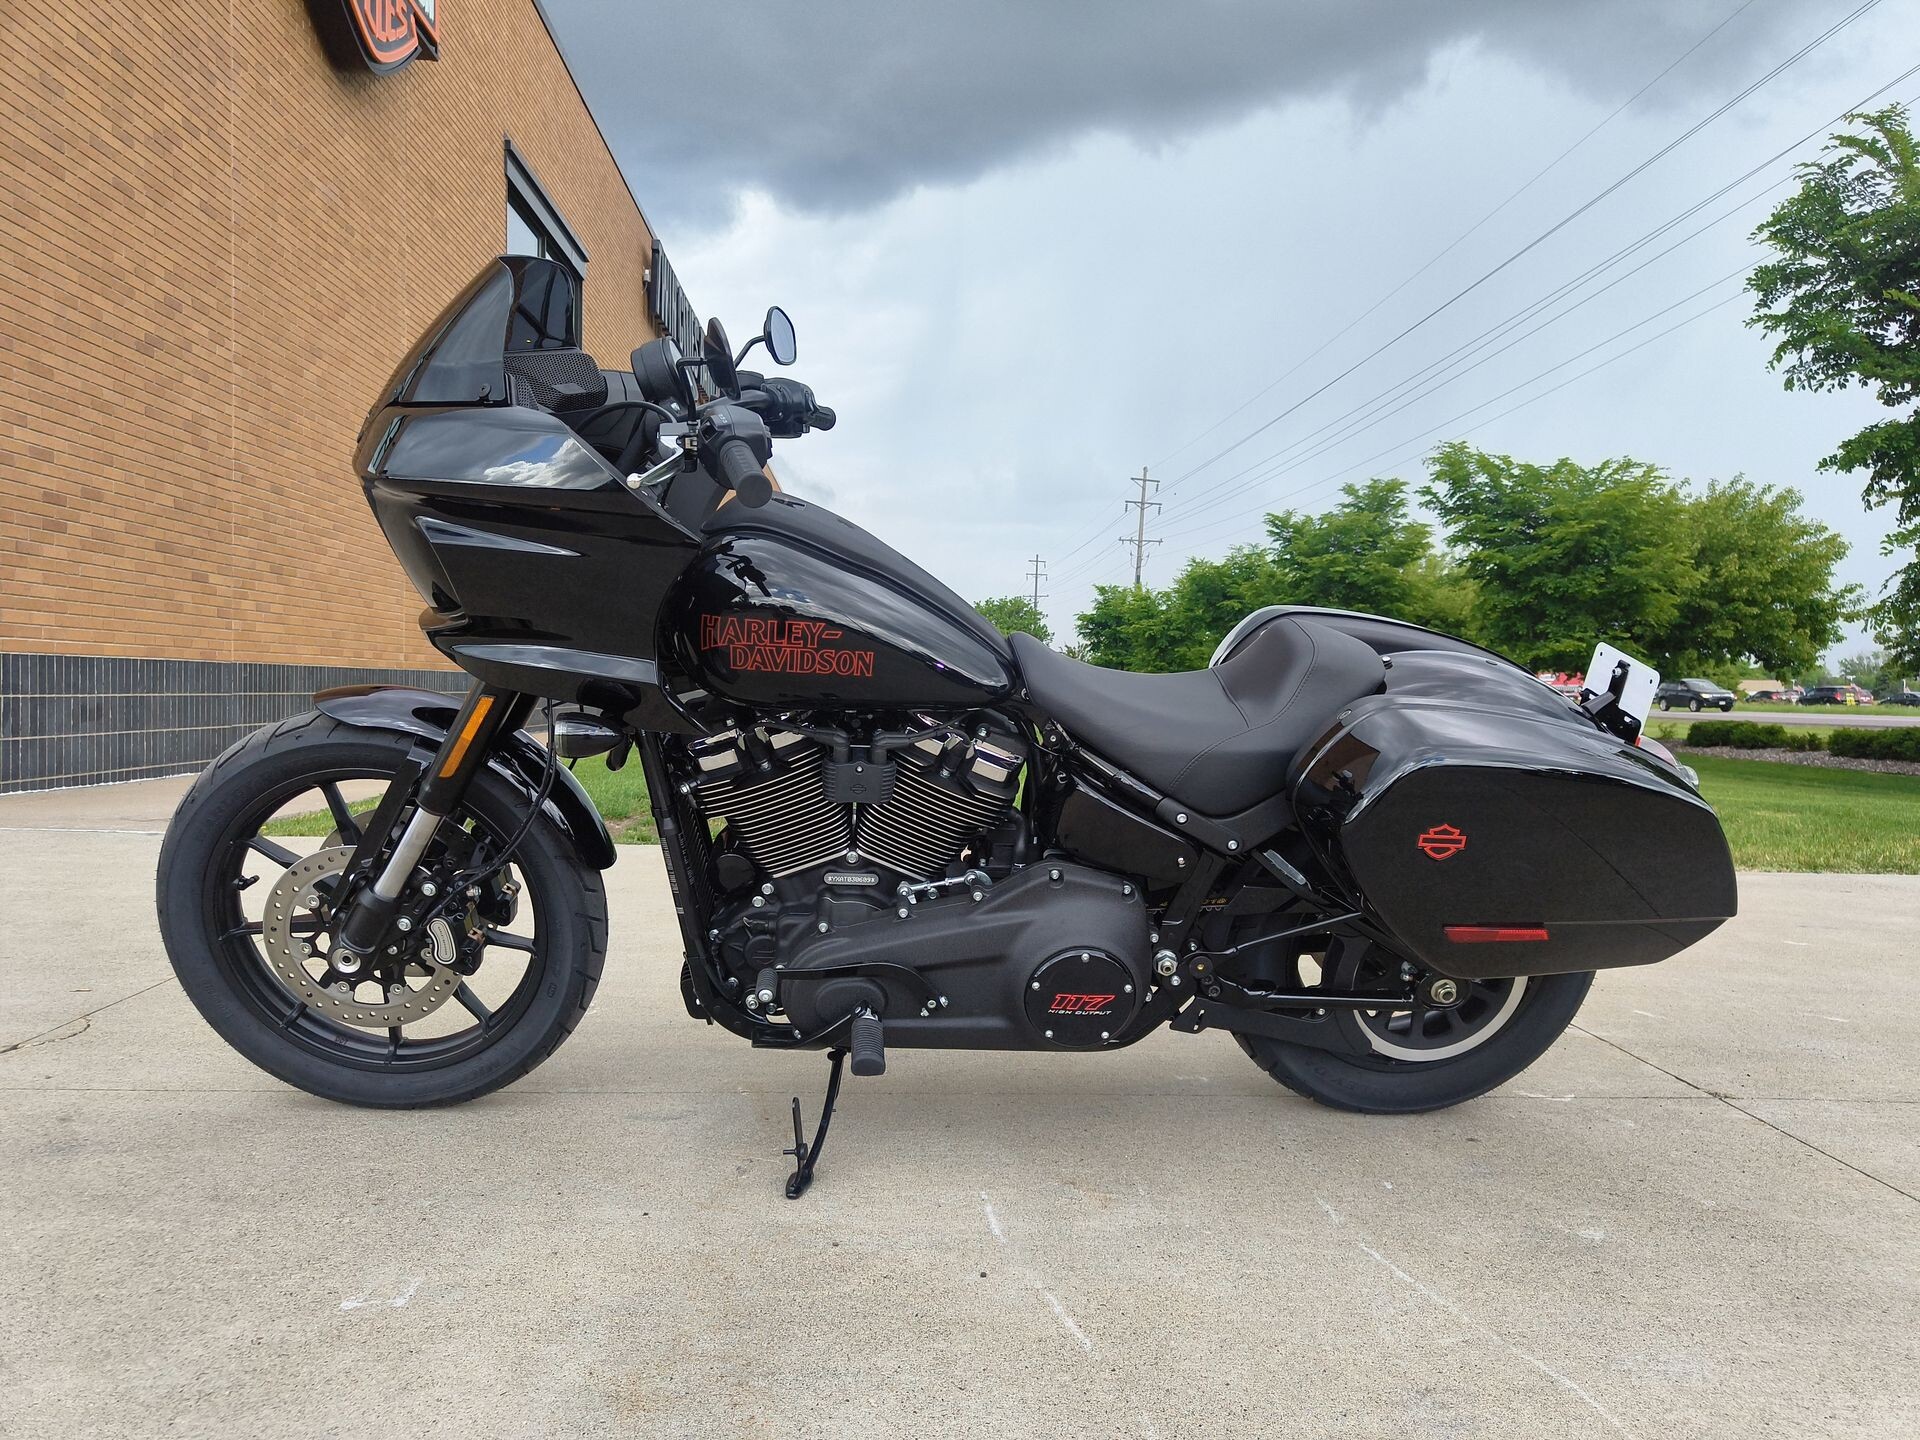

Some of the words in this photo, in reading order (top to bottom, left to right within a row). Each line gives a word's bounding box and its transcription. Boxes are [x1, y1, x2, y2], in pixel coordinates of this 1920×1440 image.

[701, 614, 843, 650] HARLEY-
[730, 645, 874, 676] DAVIDSON
[1051, 994, 1115, 1010] 117
